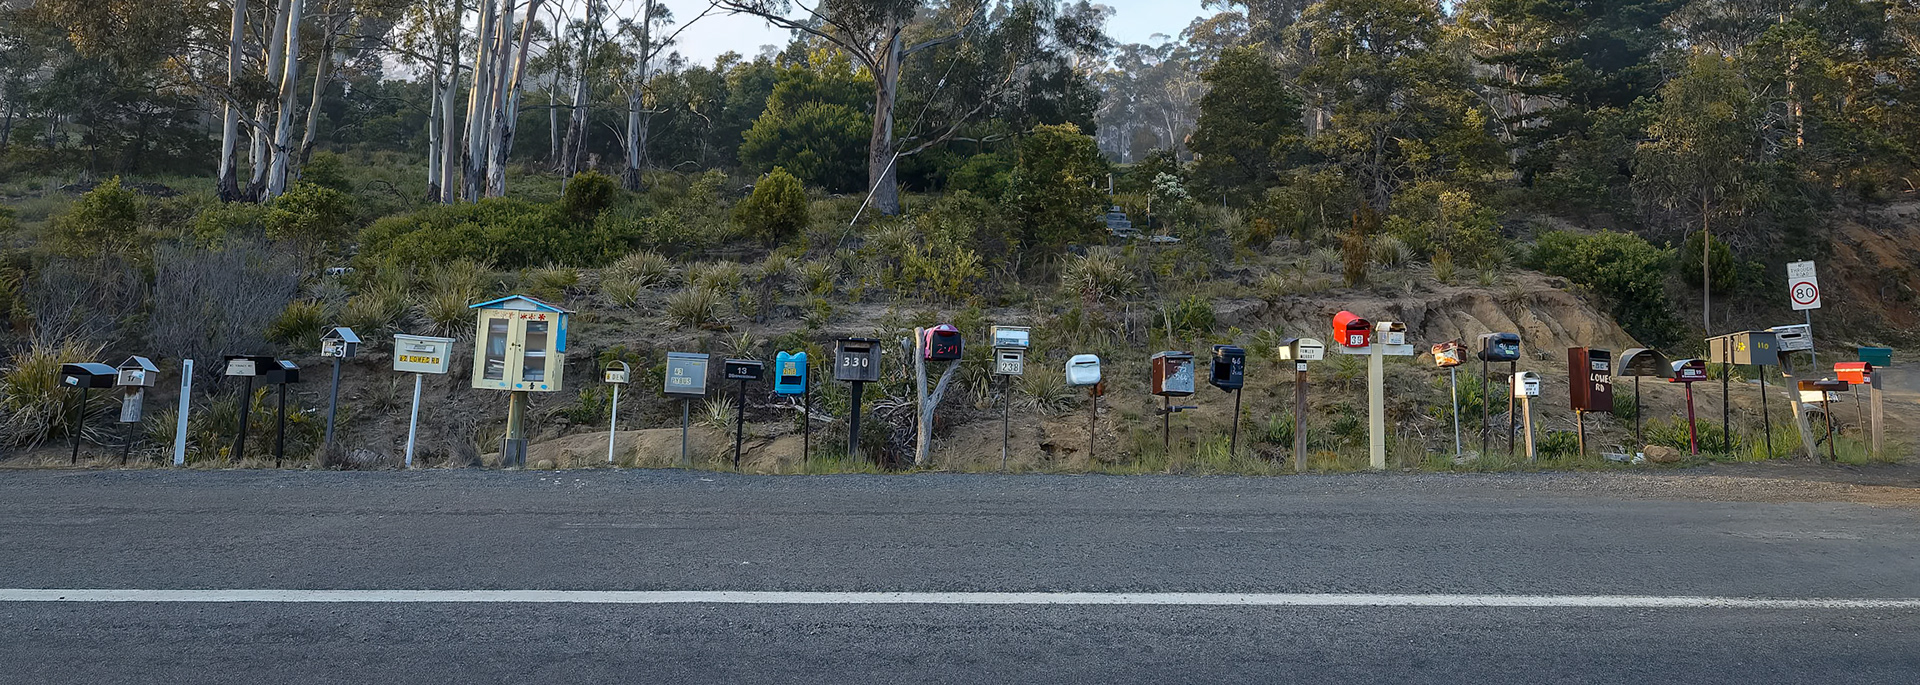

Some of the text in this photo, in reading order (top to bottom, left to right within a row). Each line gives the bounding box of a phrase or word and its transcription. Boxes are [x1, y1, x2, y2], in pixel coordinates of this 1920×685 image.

[1796, 288, 1814, 299] 80
[1351, 335, 1363, 345] 39
[334, 345, 344, 358] 3
[843, 357, 869, 368] 330
[1002, 363, 1020, 372] 238
[737, 367, 748, 375] 13
[1590, 373, 1613, 384] LOWES
[1595, 383, 1605, 393] RD
